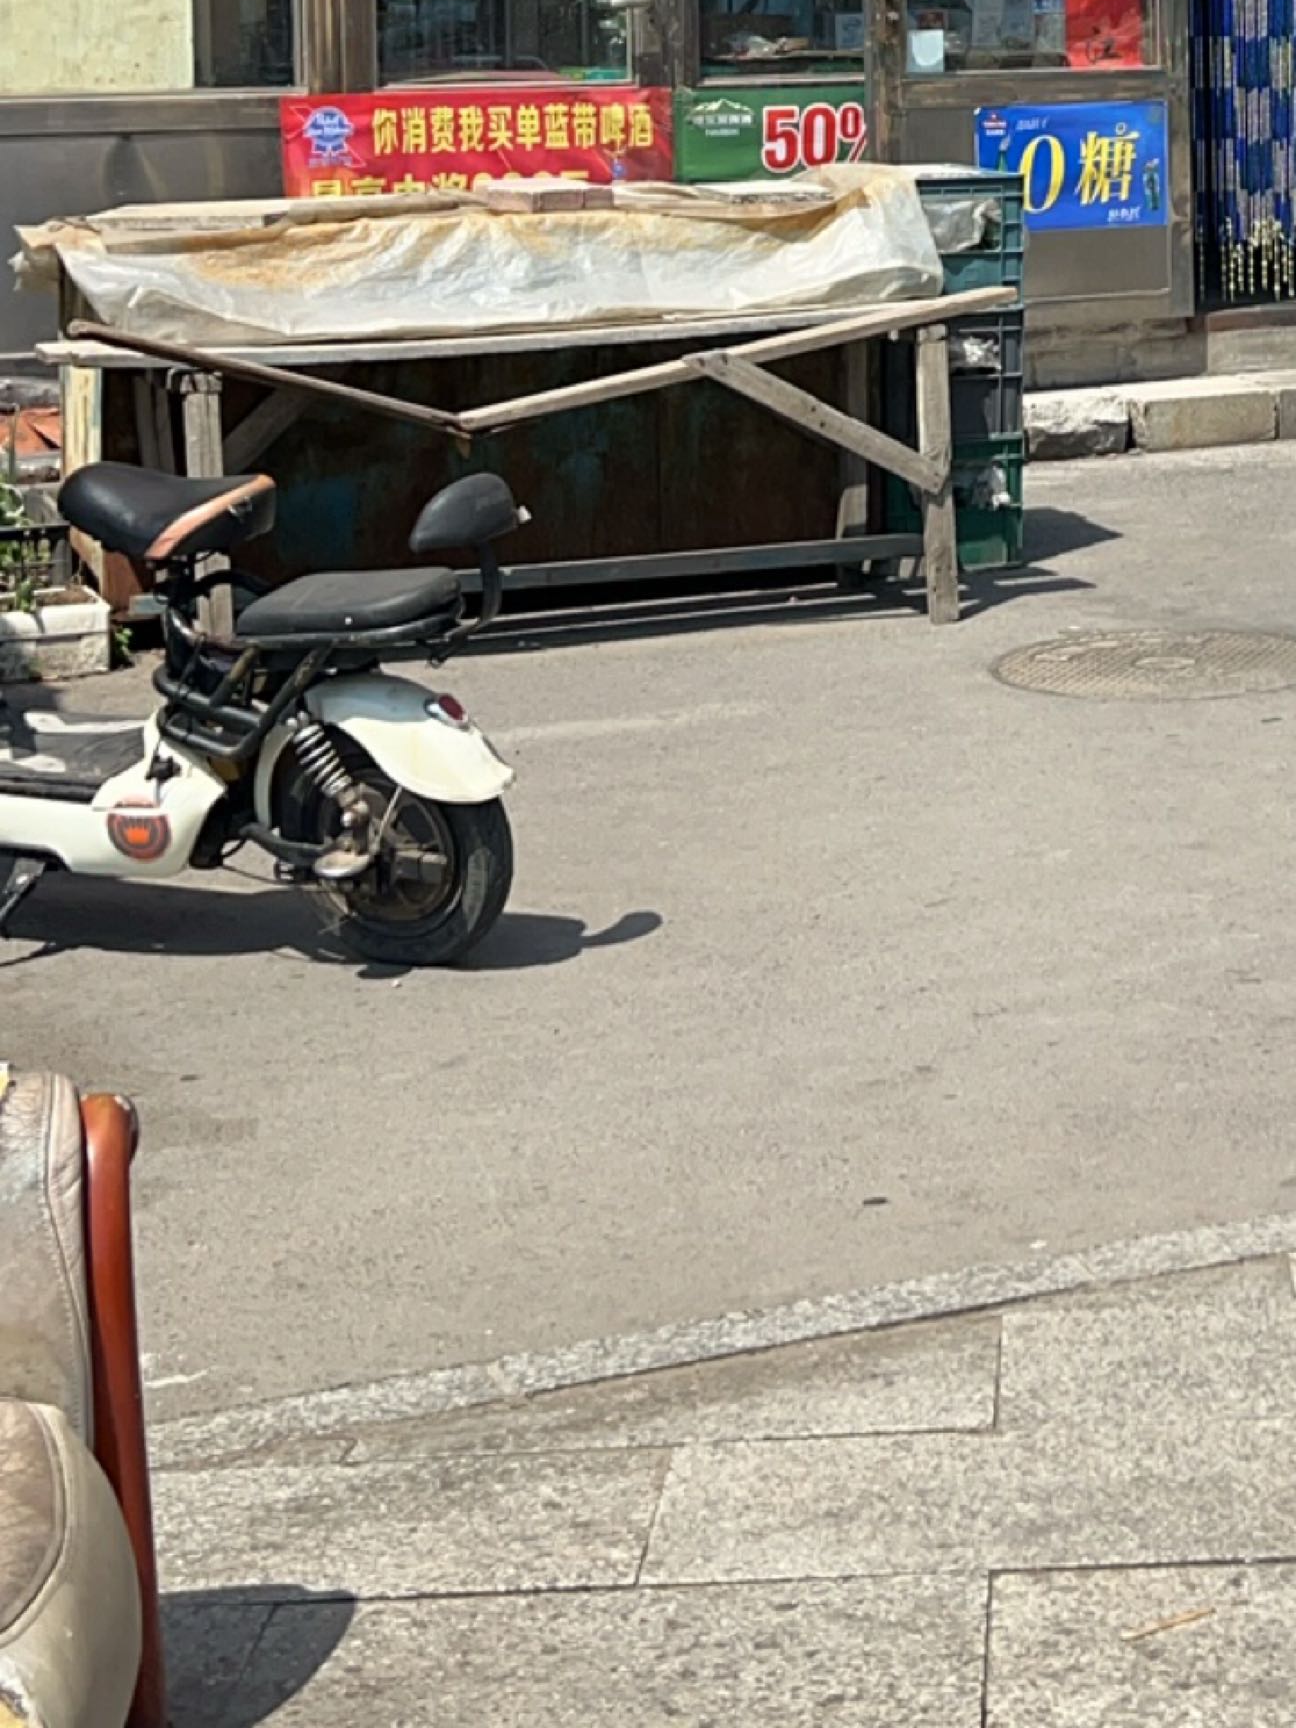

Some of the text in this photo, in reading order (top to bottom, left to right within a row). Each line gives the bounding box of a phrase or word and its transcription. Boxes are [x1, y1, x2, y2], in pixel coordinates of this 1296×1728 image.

[371, 103, 655, 157] 你消费我买单蓝带啤酒
[1020, 124, 1141, 215] 0糖
